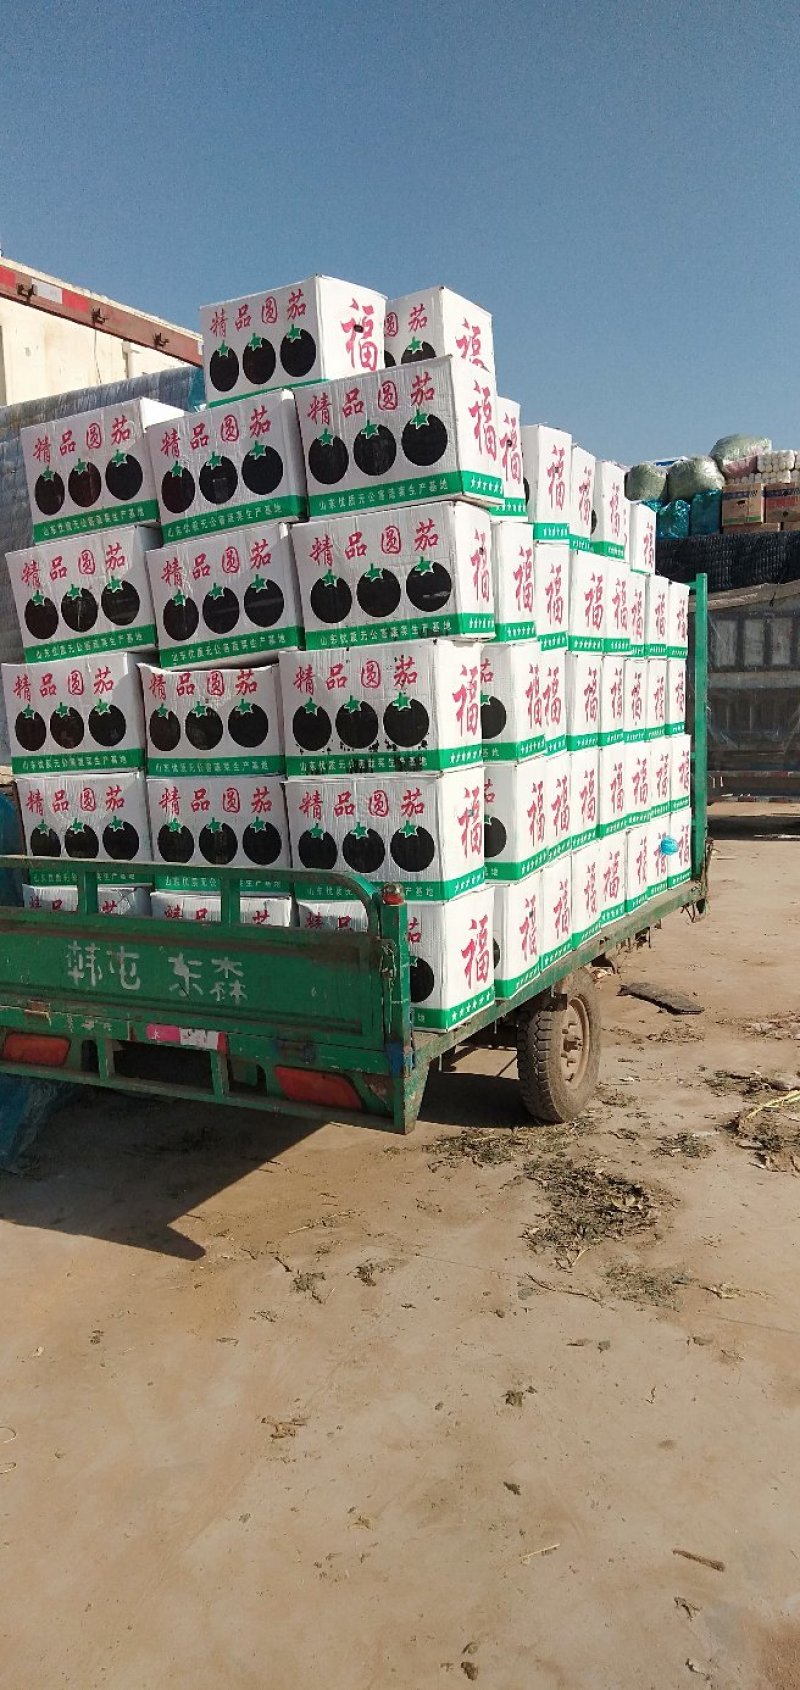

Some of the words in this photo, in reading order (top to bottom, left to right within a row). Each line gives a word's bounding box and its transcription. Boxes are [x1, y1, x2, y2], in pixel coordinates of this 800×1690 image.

[211, 289, 306, 336] 精品圆茄
[340, 298, 378, 371] 福
[307, 371, 435, 424] 精品圆茄
[468, 381, 497, 460] 福
[33, 416, 131, 463] 精品圆茄
[160, 406, 272, 458] 精品圆茄
[499, 413, 522, 483] 福
[546, 445, 565, 511] 福
[579, 466, 592, 528] 福
[21, 543, 126, 588] 精品圆茄
[161, 539, 272, 586] 精品圆茄
[310, 518, 439, 566] 精品圆茄
[470, 528, 490, 602] 福
[512, 546, 534, 613] 福
[545, 564, 563, 625] 福
[584, 572, 604, 630] 福
[612, 577, 628, 629] 福
[13, 667, 116, 702] 精品圆茄
[148, 669, 258, 701] 精品圆茄
[294, 656, 419, 695] 精品圆茄
[452, 664, 480, 736] 福
[525, 663, 542, 729] 福
[543, 666, 561, 725] 福
[584, 666, 599, 722] 福
[610, 668, 622, 718] 福
[26, 785, 125, 816] 精品圆茄
[159, 786, 272, 816] 精品圆茄
[299, 787, 425, 820] 精品圆茄
[527, 780, 545, 847] 福
[551, 775, 570, 836] 福
[580, 769, 596, 823] 福
[610, 762, 624, 813] 福
[457, 787, 483, 859] 福
[603, 851, 620, 902] 福
[519, 895, 537, 961] 福
[553, 879, 568, 939] 福
[460, 914, 491, 990] 福
